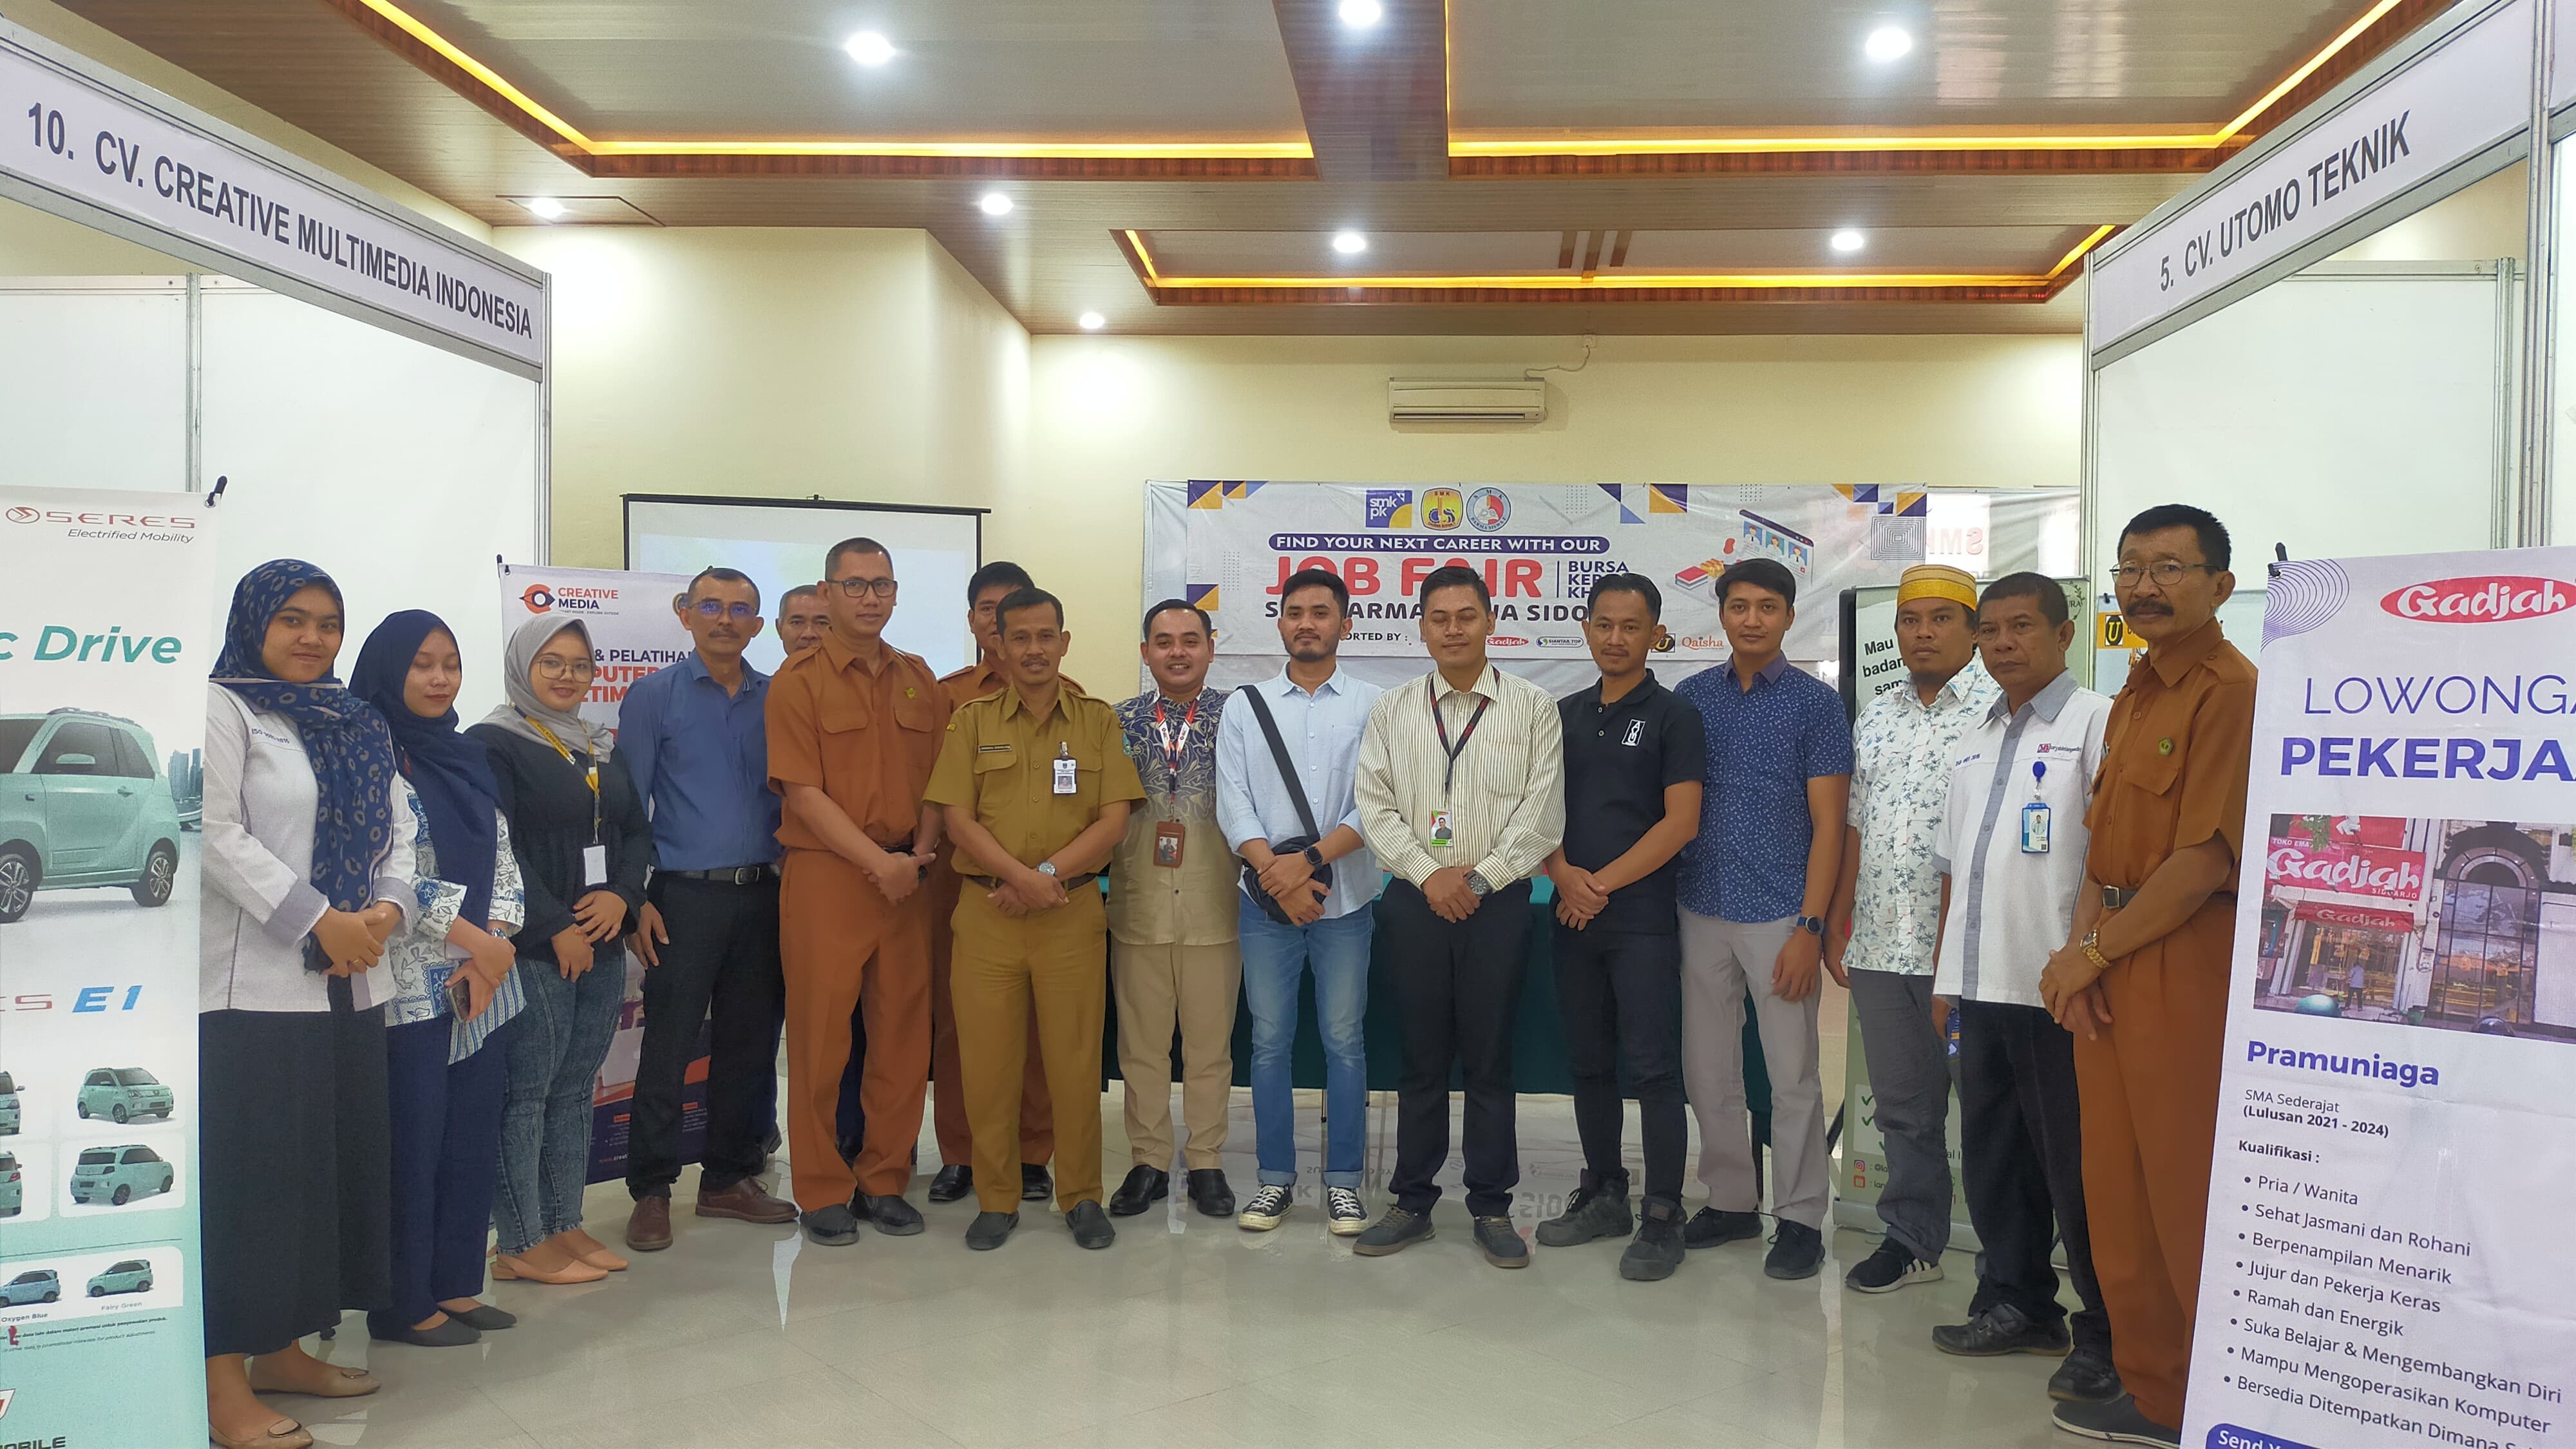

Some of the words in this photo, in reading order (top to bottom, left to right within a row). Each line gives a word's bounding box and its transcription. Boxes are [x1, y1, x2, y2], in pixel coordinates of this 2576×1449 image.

[2161, 256, 2174, 292] 5.
[2184, 230, 2213, 277] CV.
[2220, 178, 2300, 258] UTOMO
[2308, 109, 2411, 207] TEKNIK
[28, 102, 75, 160] 10.
[95, 130, 144, 188] CV.
[154, 155, 290, 245] CREATIVE
[297, 214, 431, 301] MULTIMEDIA
[435, 272, 533, 340] INDONESIA
[1370, 496, 1397, 507] smk
[1370, 506, 1387, 520] pk
[46, 511, 195, 529] SERES
[68, 528, 138, 540] Electrified
[140, 532, 194, 544] Mobility
[1276, 536, 1319, 548] FIND
[1324, 537, 1375, 549] YOUR
[1380, 538, 1429, 549] NEXT
[1433, 538, 1502, 551] CAREER
[1506, 539, 1554, 551] WITH
[1561, 540, 1600, 551] OUR
[1401, 557, 1542, 598] FIR
[1568, 561, 1629, 573] BURSA
[558, 587, 619, 599] CREATIVE
[558, 598, 600, 609] MEDIA
[2397, 582, 2566, 620] Gadjah
[33, 625, 182, 664] Drive
[1387, 632, 1401, 641] BY
[1681, 635, 1725, 650] Qaisha
[2108, 621, 2121, 642] U
[595, 649, 604, 661] &
[610, 649, 692, 663] PELATIHA
[1864, 639, 1894, 656] Mau
[2304, 674, 2576, 715] LOWONG
[2280, 737, 2576, 782] PEKERJA
[2272, 837, 2293, 846] TOKO
[2294, 840, 2313, 848] EMA
[2266, 848, 2420, 889] Gadjah
[2316, 909, 2396, 927] Gadjah
[72, 985, 142, 1013] E1
[2246, 1040, 2439, 1088] Pramuniaga
[2244, 1088, 2273, 1104] SMA
[2277, 1092, 2340, 1114] Sederajat
[2243, 1104, 2303, 1125] (Lulusan
[2307, 1113, 2338, 1130] 2021
[2350, 1119, 2389, 1139] 2024)
[2238, 1139, 2313, 1162] Kualifikasi
[2257, 1175, 2289, 1195] Pria
[2304, 1183, 2359, 1206] Wanita
[2255, 1203, 2300, 1225] Sehat
[2302, 1213, 2366, 1238] Jasmani
[2370, 1225, 2403, 1245] dan
[2407, 1231, 2472, 1258] Rohani
[2252, 1231, 2374, 1269] Berpenampilan
[2378, 1256, 2452, 1285] Menarik
[2247, 1260, 2287, 1282] Jujur
[2290, 1268, 2319, 1289] dan
[2323, 1275, 2384, 1303] Pekerja
[2389, 1291, 2441, 1314] Keras
[2247, 1289, 2300, 1314] Ramah
[2304, 1302, 2335, 1322] dan
[2339, 1309, 2404, 1338] Energik
[2244, 1317, 2280, 1340] Suka
[2284, 1327, 2341, 1358] Belajar
[2344, 1341, 2358, 1357] &
[2362, 1344, 2521, 1396] Mengembangkan
[2527, 1381, 2562, 1406] Diri
[2240, 1345, 2300, 1376] Mampu
[2304, 1361, 2450, 1411] Mengoperasikan
[2454, 1397, 2552, 1435] Komputer
[2237, 1375, 2304, 1406] Bersedia
[2309, 1393, 2422, 1435] Ditempatkan
